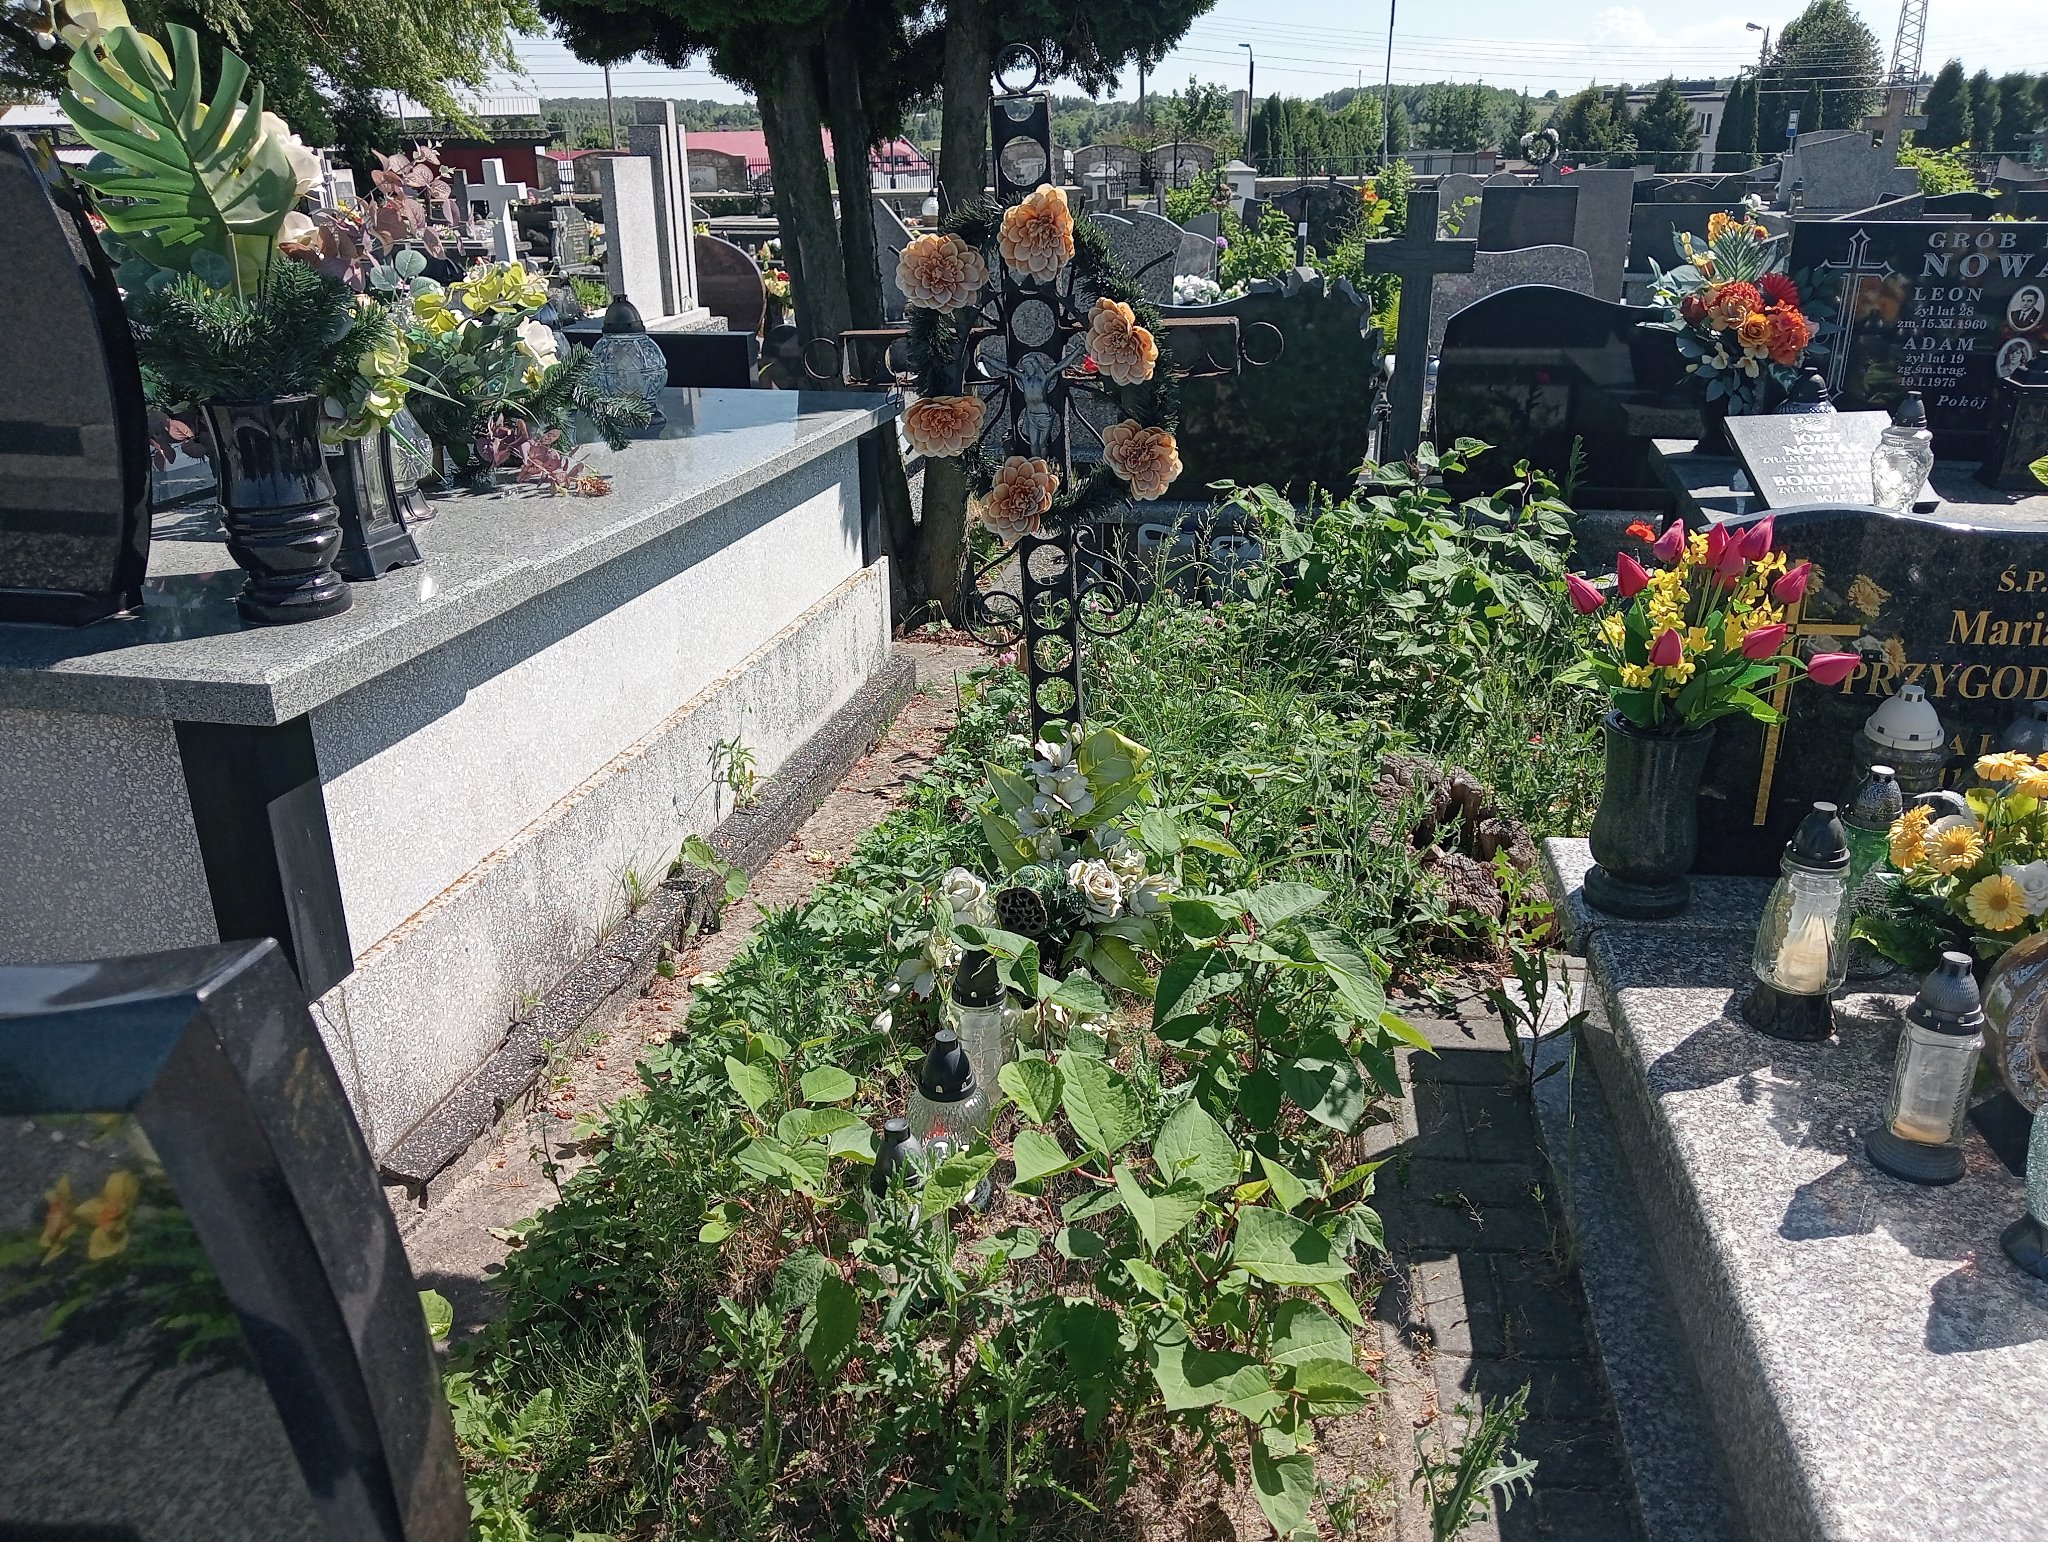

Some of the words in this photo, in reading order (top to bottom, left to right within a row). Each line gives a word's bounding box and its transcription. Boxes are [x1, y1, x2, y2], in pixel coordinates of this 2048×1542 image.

[1928, 227, 2017, 248] GRÓB
[1913, 287, 1983, 301] LEON
[1937, 305, 1955, 316] lat
[1959, 305, 1975, 316] 28
[1903, 337, 1976, 351] ADAM
[1928, 353, 1945, 364] lat
[1950, 354, 1965, 364] 19
[1936, 395, 1988, 409] Pokój
[1997, 564, 2047, 593] Ś.P.
